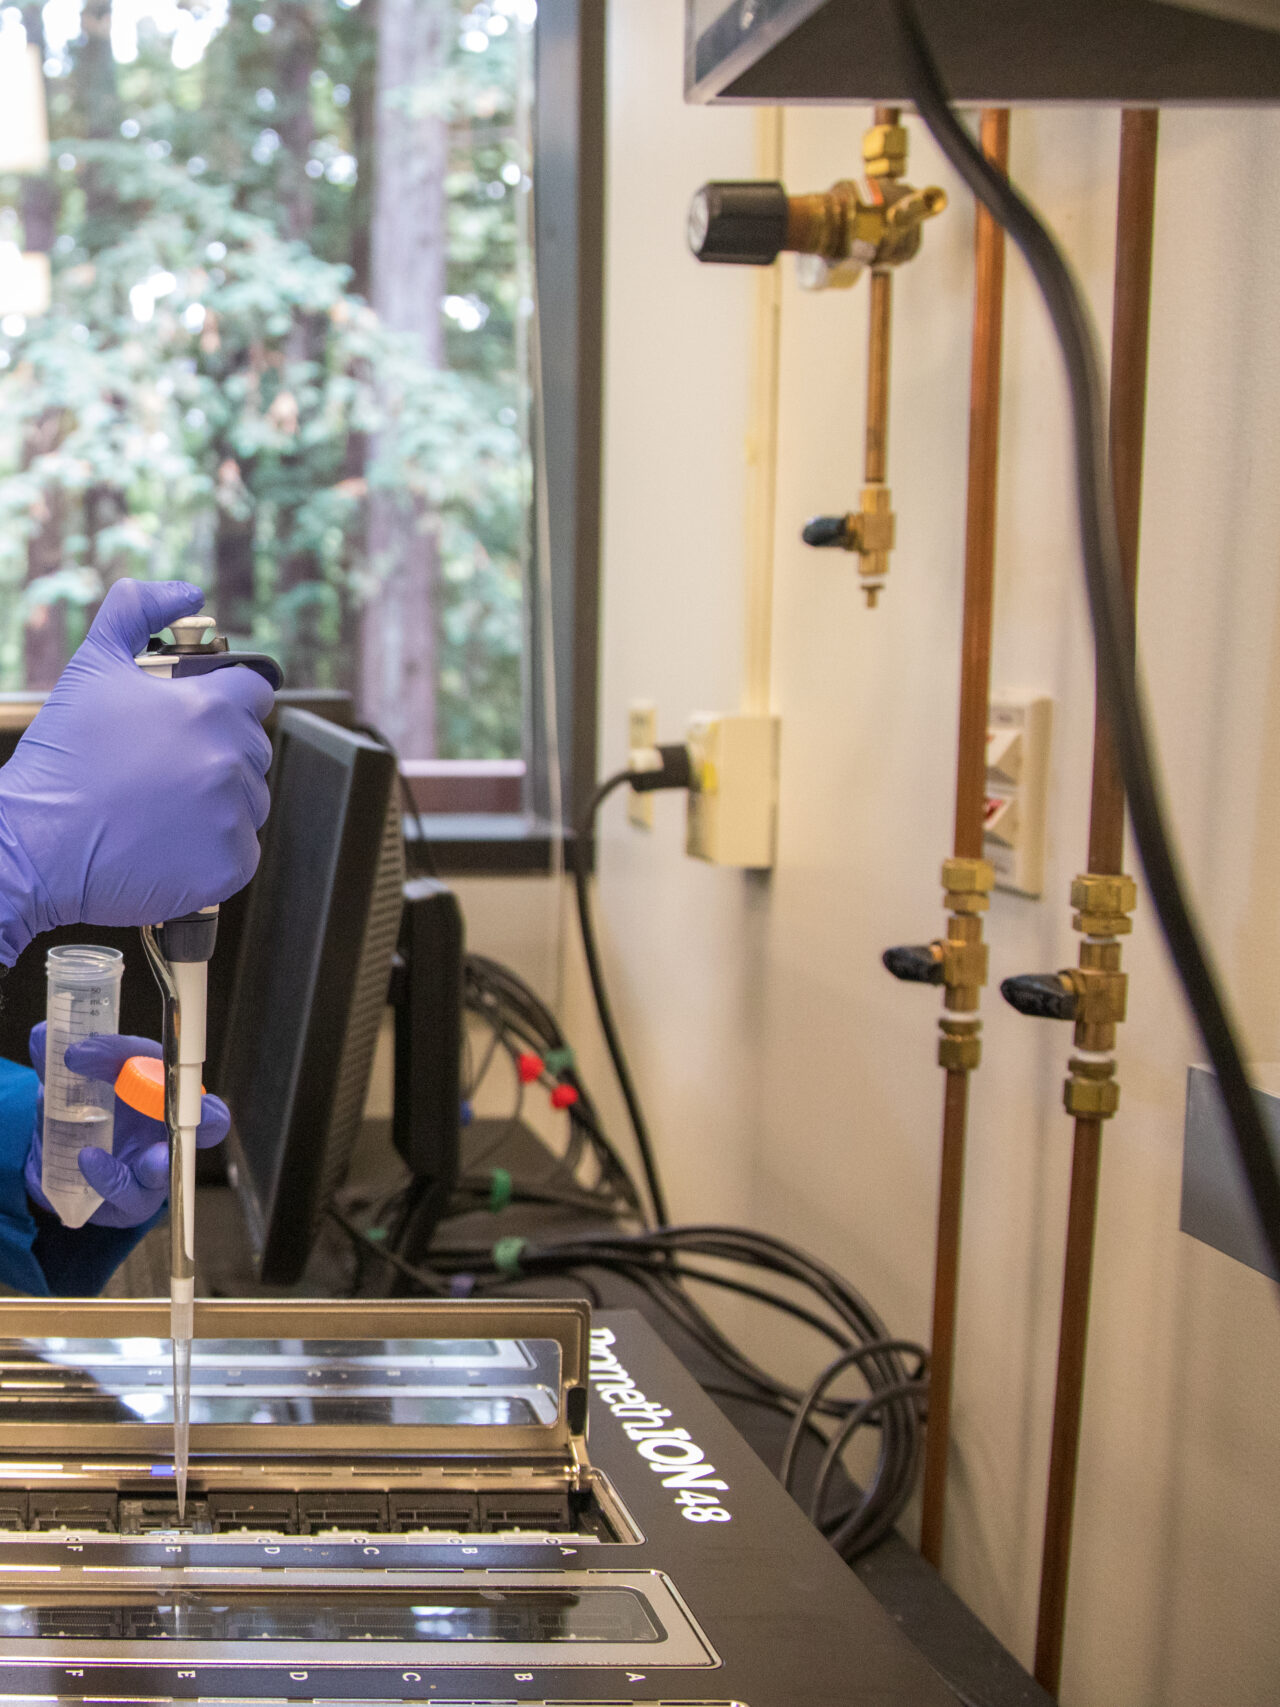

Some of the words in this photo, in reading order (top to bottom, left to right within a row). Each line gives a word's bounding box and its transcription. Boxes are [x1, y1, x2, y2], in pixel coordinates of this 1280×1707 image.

[264, 1547, 281, 1555] D
[363, 1547, 380, 1555] C
[462, 1547, 478, 1555] B
[560, 1547, 578, 1555] A
[65, 1669, 84, 1677] F
[177, 1670, 196, 1678] E
[289, 1672, 309, 1681] D
[402, 1672, 422, 1682] C
[513, 1672, 534, 1682] B
[625, 1672, 646, 1682] A
